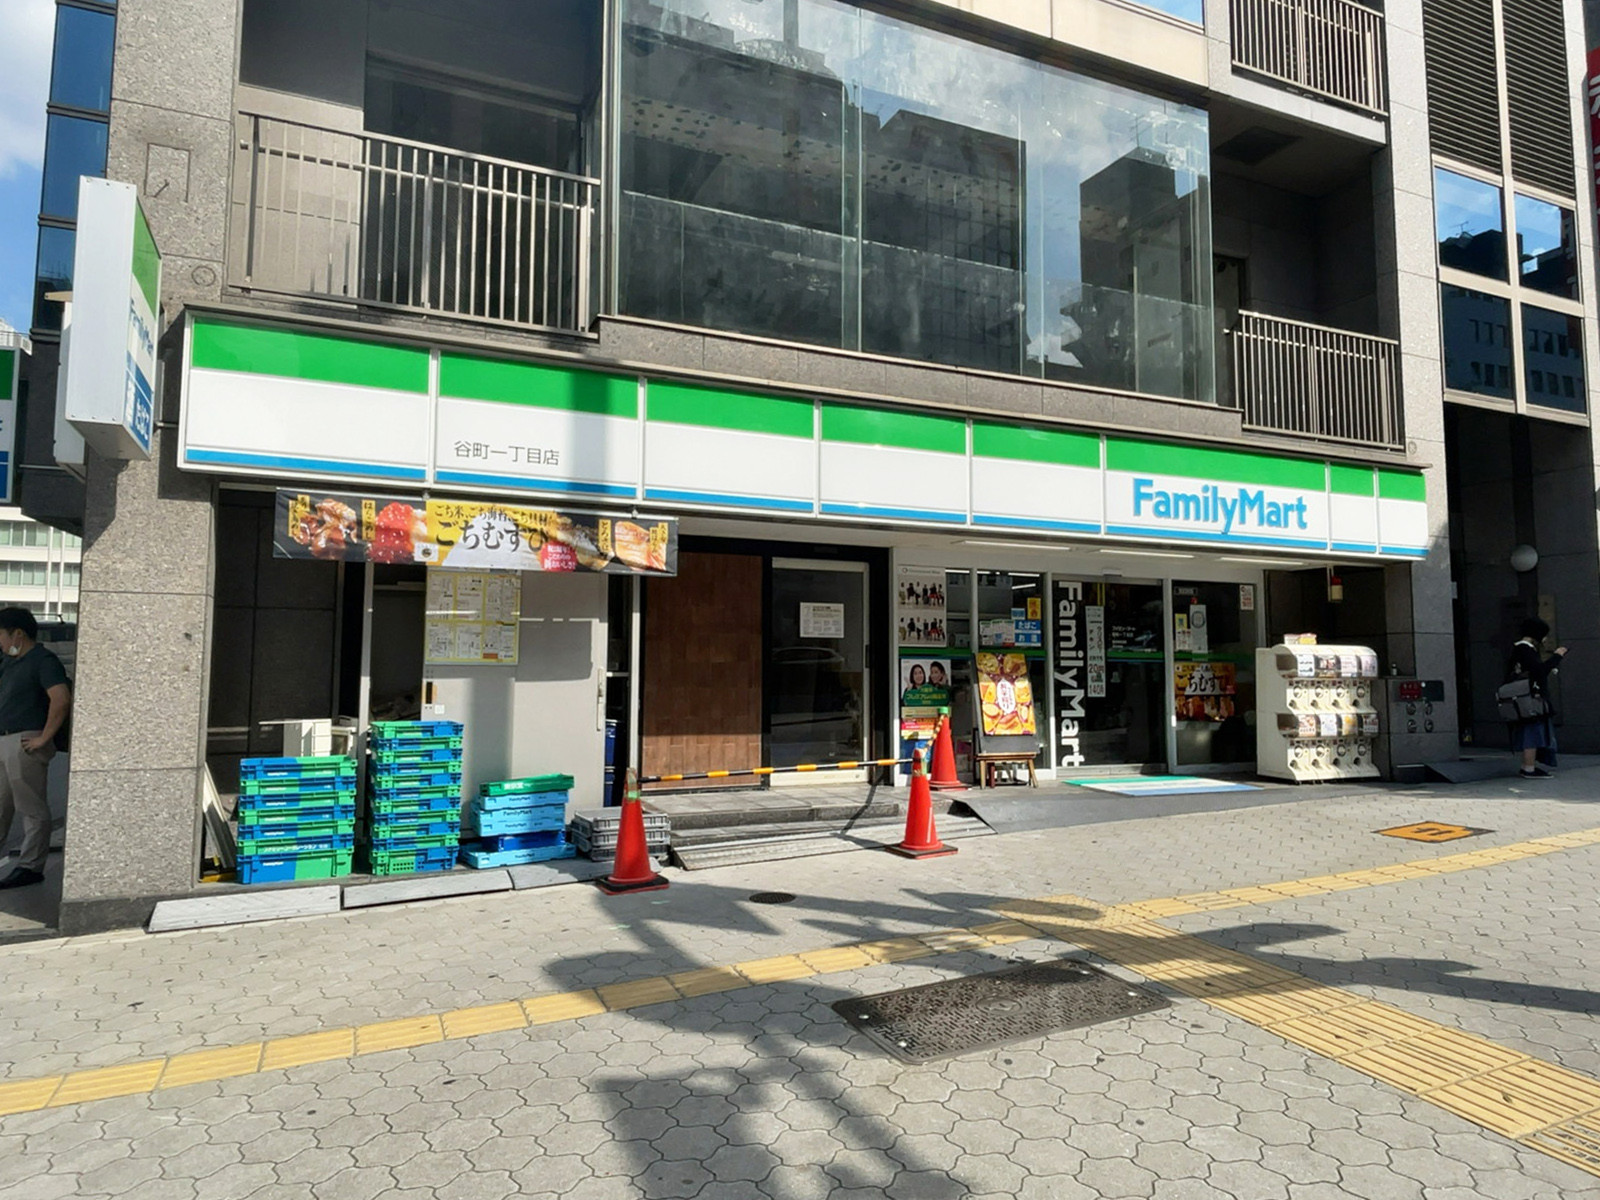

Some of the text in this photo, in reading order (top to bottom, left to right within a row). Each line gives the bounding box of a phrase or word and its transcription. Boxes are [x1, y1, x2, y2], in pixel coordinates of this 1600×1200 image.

[454, 440, 560, 465] 谷町一丁目店
[1133, 477, 1308, 535] FamilyMart
[1054, 581, 1086, 768] FamilyMart
